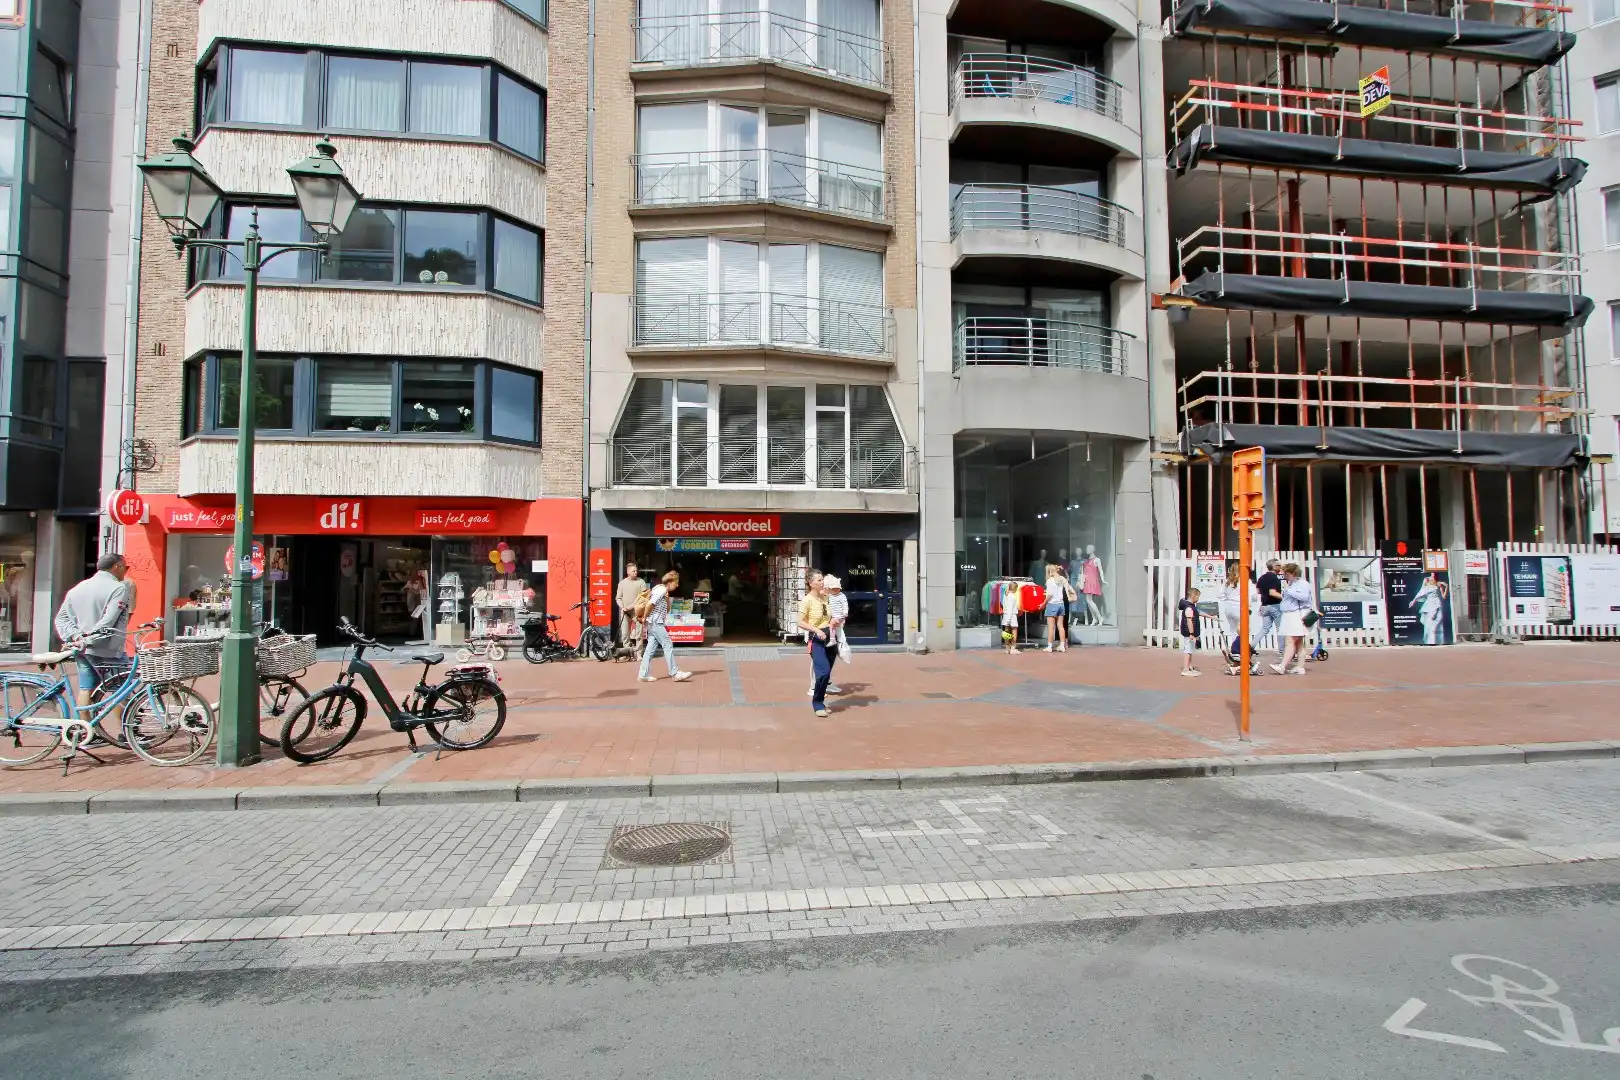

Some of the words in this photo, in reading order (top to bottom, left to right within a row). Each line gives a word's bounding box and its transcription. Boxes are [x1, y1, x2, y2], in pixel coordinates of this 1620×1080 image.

[1362, 84, 1390, 105] DEVA
[170, 511, 194, 525] just
[196, 511, 217, 525] feel
[216, 512, 237, 527] goo
[420, 513, 443, 527] just
[444, 513, 464, 527] feel
[464, 513, 490, 527] good
[663, 518, 772, 532] BoekenVoordeel
